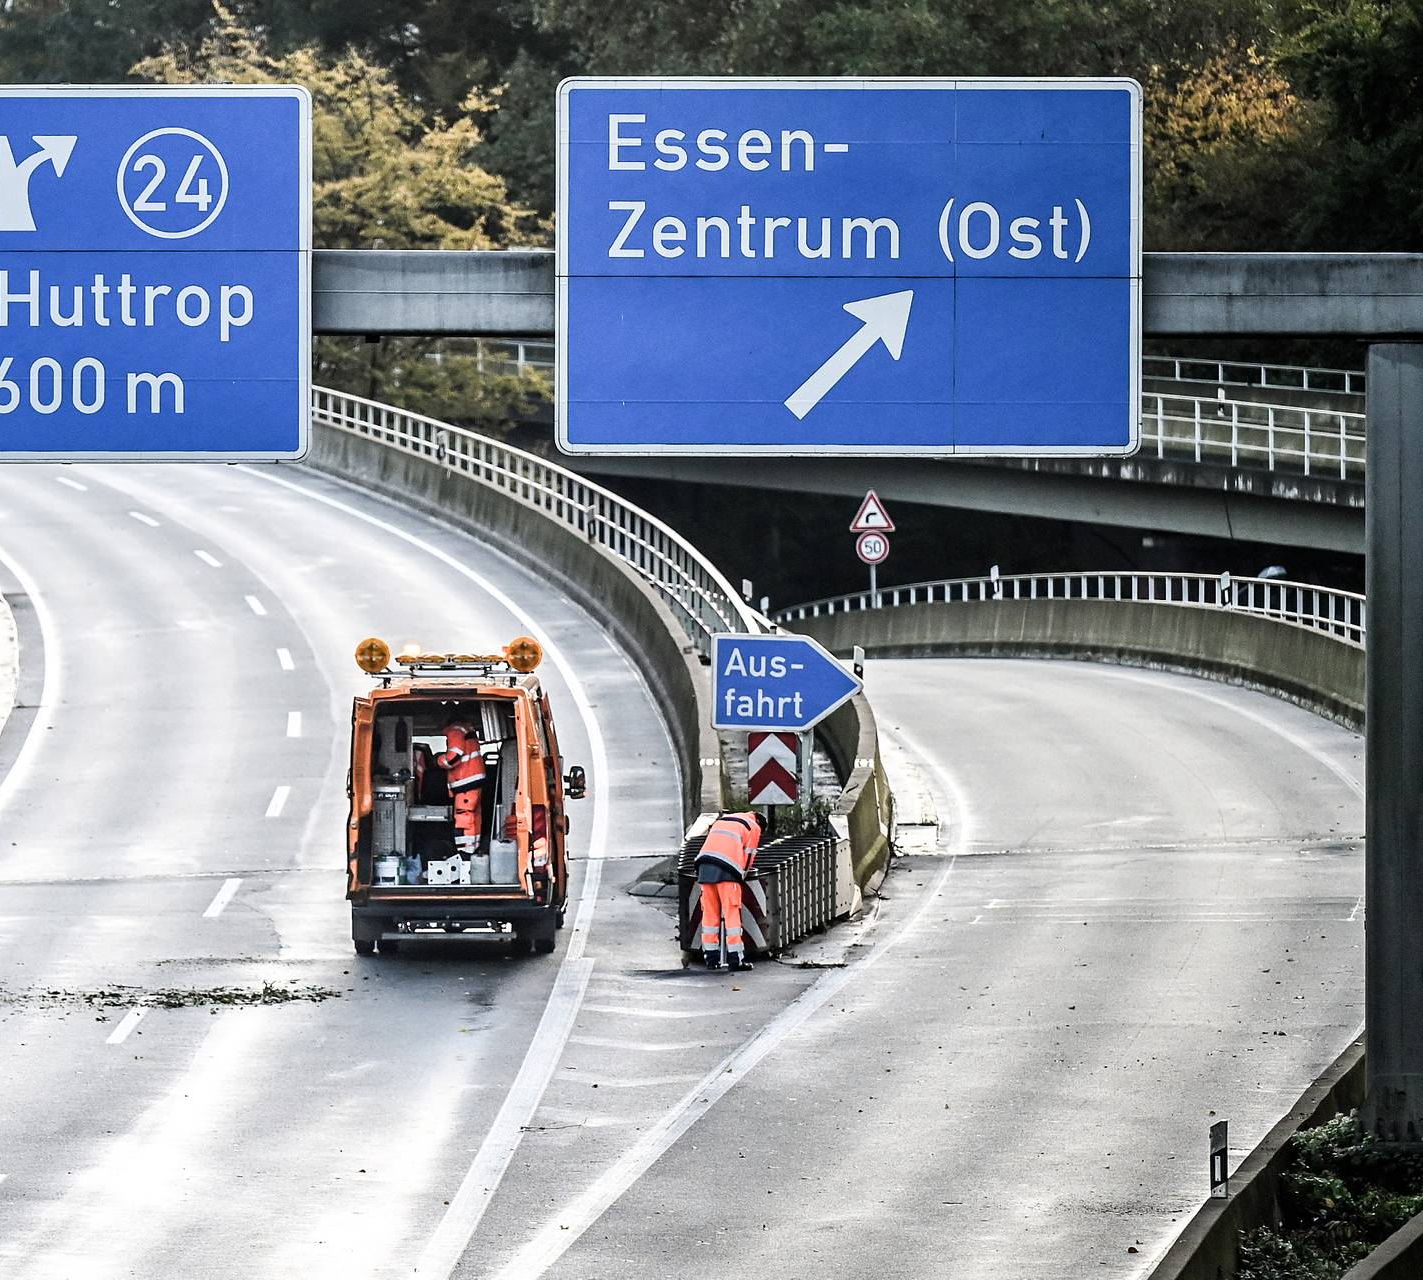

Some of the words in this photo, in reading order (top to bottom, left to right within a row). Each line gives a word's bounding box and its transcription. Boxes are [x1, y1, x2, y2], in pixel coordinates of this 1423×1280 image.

[608, 113, 849, 172] Essen-
[134, 154, 212, 212] 24
[608, 200, 900, 259] Zentrum
[938, 198, 1091, 263] (Ost)
[127, 372, 185, 414] m
[864, 539, 882, 554] 50
[724, 647, 804, 678] Aus-
[724, 688, 804, 719] fahrt
